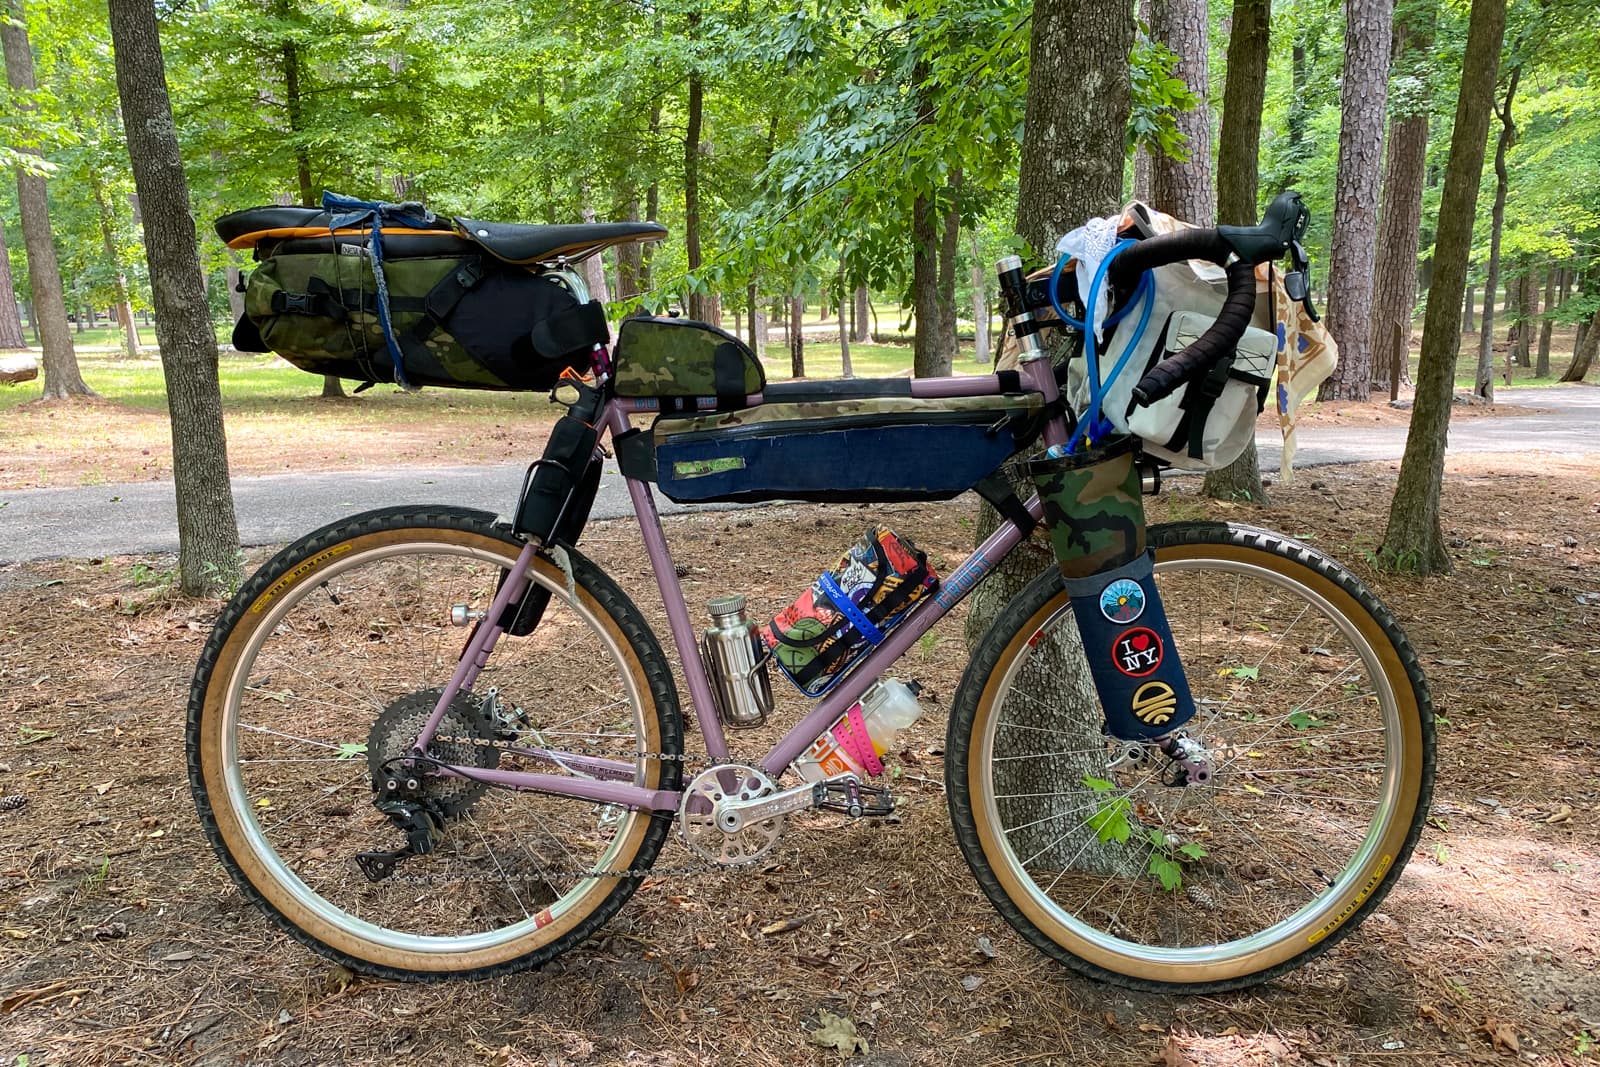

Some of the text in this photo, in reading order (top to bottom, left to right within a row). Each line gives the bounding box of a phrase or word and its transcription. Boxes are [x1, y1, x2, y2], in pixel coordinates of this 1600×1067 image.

[269, 551, 334, 597] THE HOMAGE
[934, 552, 991, 609] CRUST
[1121, 639, 1134, 656] I
[1122, 646, 1159, 672] NY
[1323, 899, 1359, 932] HOMAGE
